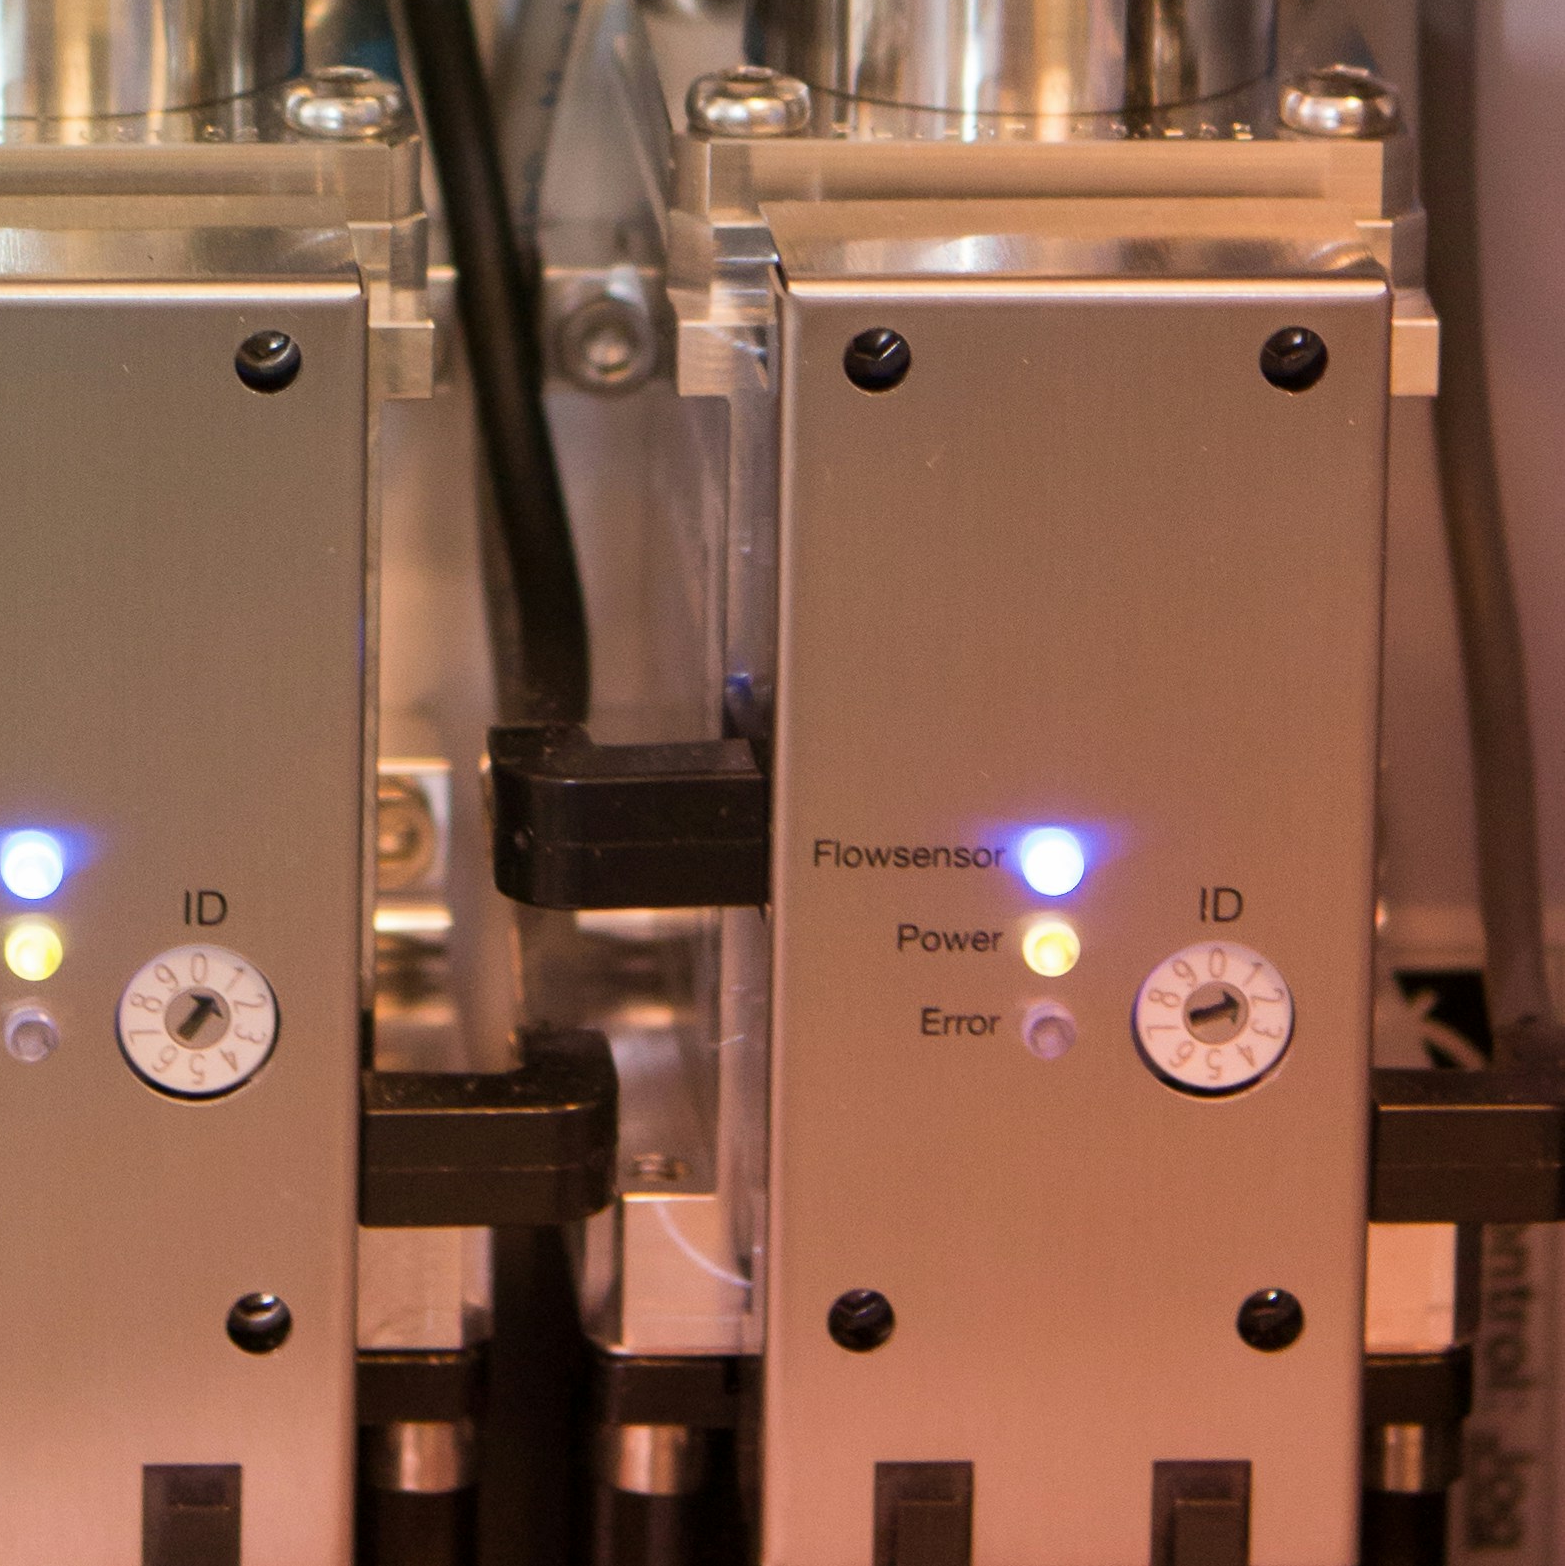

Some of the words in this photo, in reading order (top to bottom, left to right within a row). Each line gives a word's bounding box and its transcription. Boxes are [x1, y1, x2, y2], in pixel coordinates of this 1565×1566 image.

[811, 838, 1006, 871] Flowsensor
[183, 889, 229, 927] ID
[1198, 887, 1245, 924] ID
[896, 923, 1004, 953] Power
[153, 962, 180, 990] 9
[190, 952, 207, 983] 0
[1171, 958, 1198, 987] 9
[1209, 946, 1227, 979] 0
[1244, 960, 1265, 984] 1
[225, 965, 245, 989] 1
[131, 993, 163, 1014] 8
[232, 992, 267, 1015] 2
[1147, 987, 1181, 1009] 8
[1250, 987, 1285, 1010] 2
[127, 1026, 160, 1045] 7
[234, 1026, 267, 1045] 3
[920, 1007, 1001, 1037] Error
[1146, 1022, 1179, 1040] 7
[1250, 1020, 1283, 1042] 3
[151, 1046, 180, 1074] 6
[219, 1048, 239, 1074] 4
[1167, 1039, 1196, 1068] 6
[1205, 1047, 1224, 1081] 5
[1235, 1043, 1257, 1069] 4
[189, 1052, 207, 1086] 5
